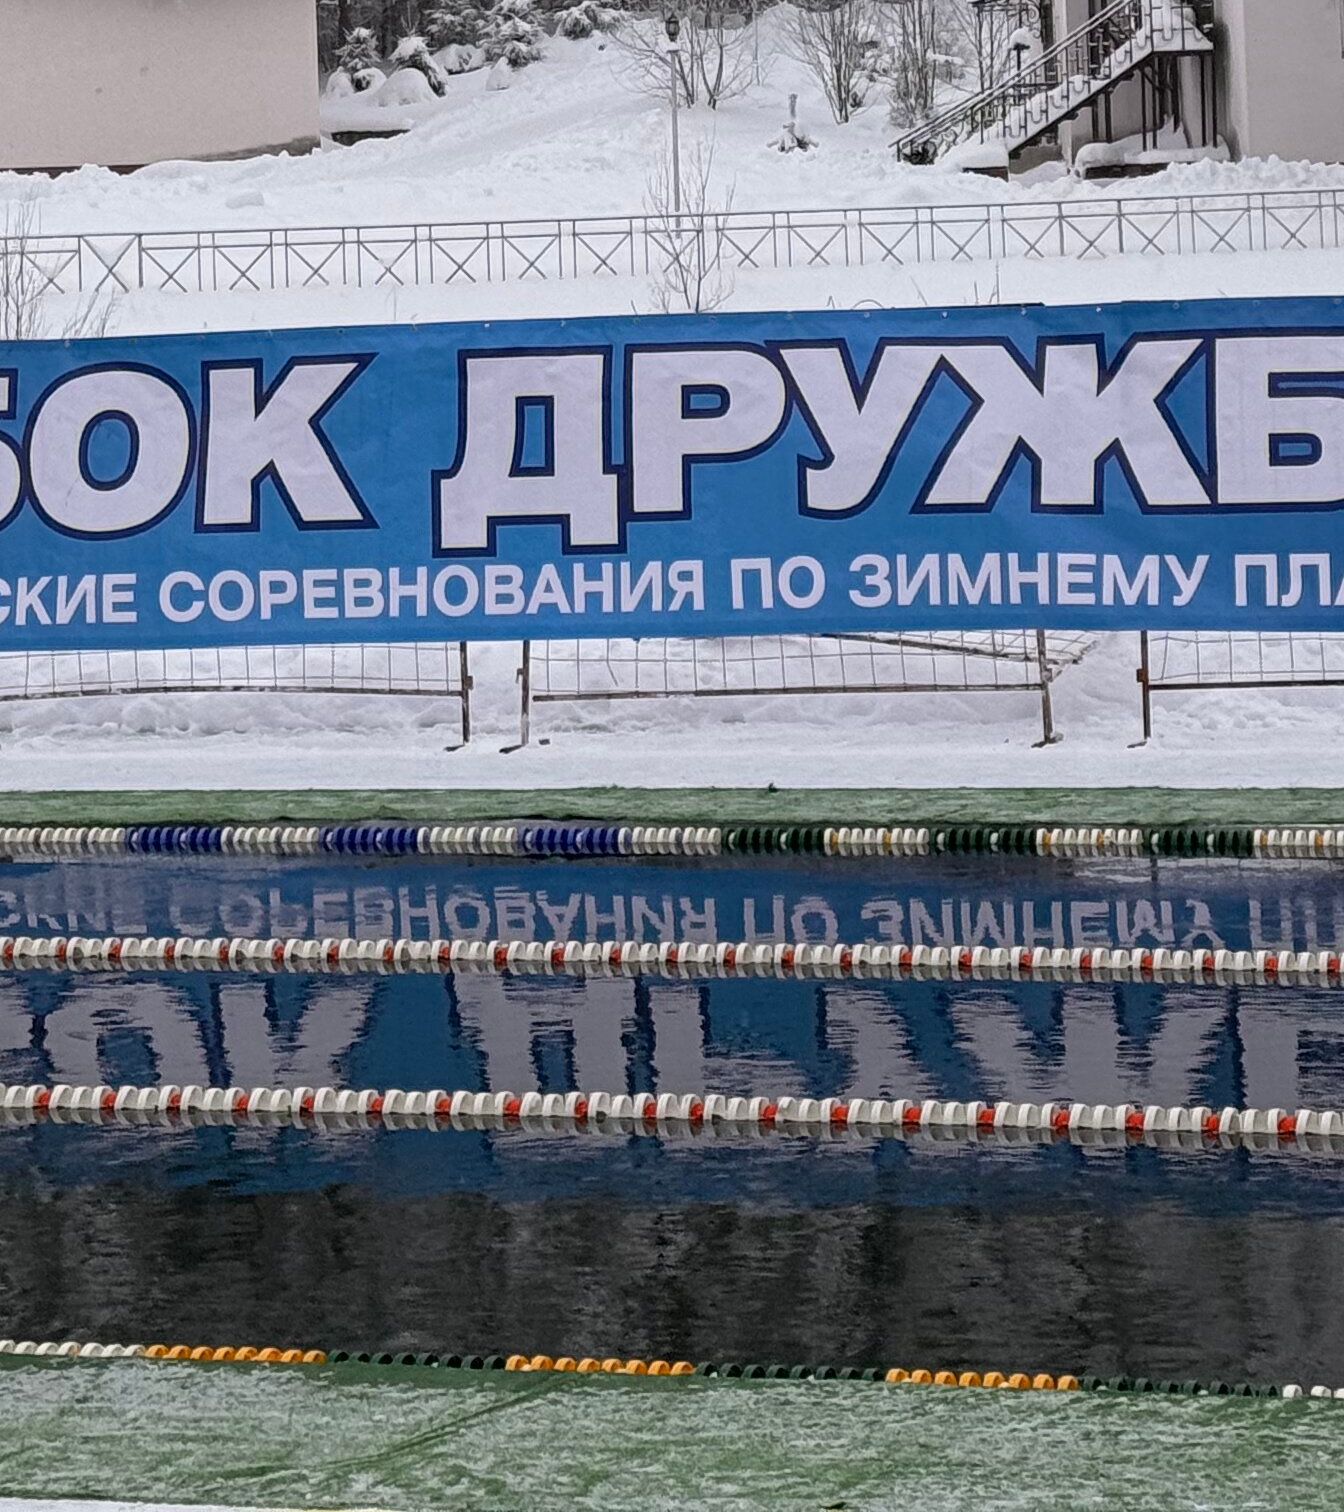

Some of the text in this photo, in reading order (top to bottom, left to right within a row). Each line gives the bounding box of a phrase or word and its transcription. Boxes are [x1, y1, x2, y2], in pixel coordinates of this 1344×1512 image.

[159, 559, 705, 622] СОРЕВНОВАНИЯ
[730, 555, 827, 609] ПО
[848, 552, 1210, 608] ЗИМНЕМУ
